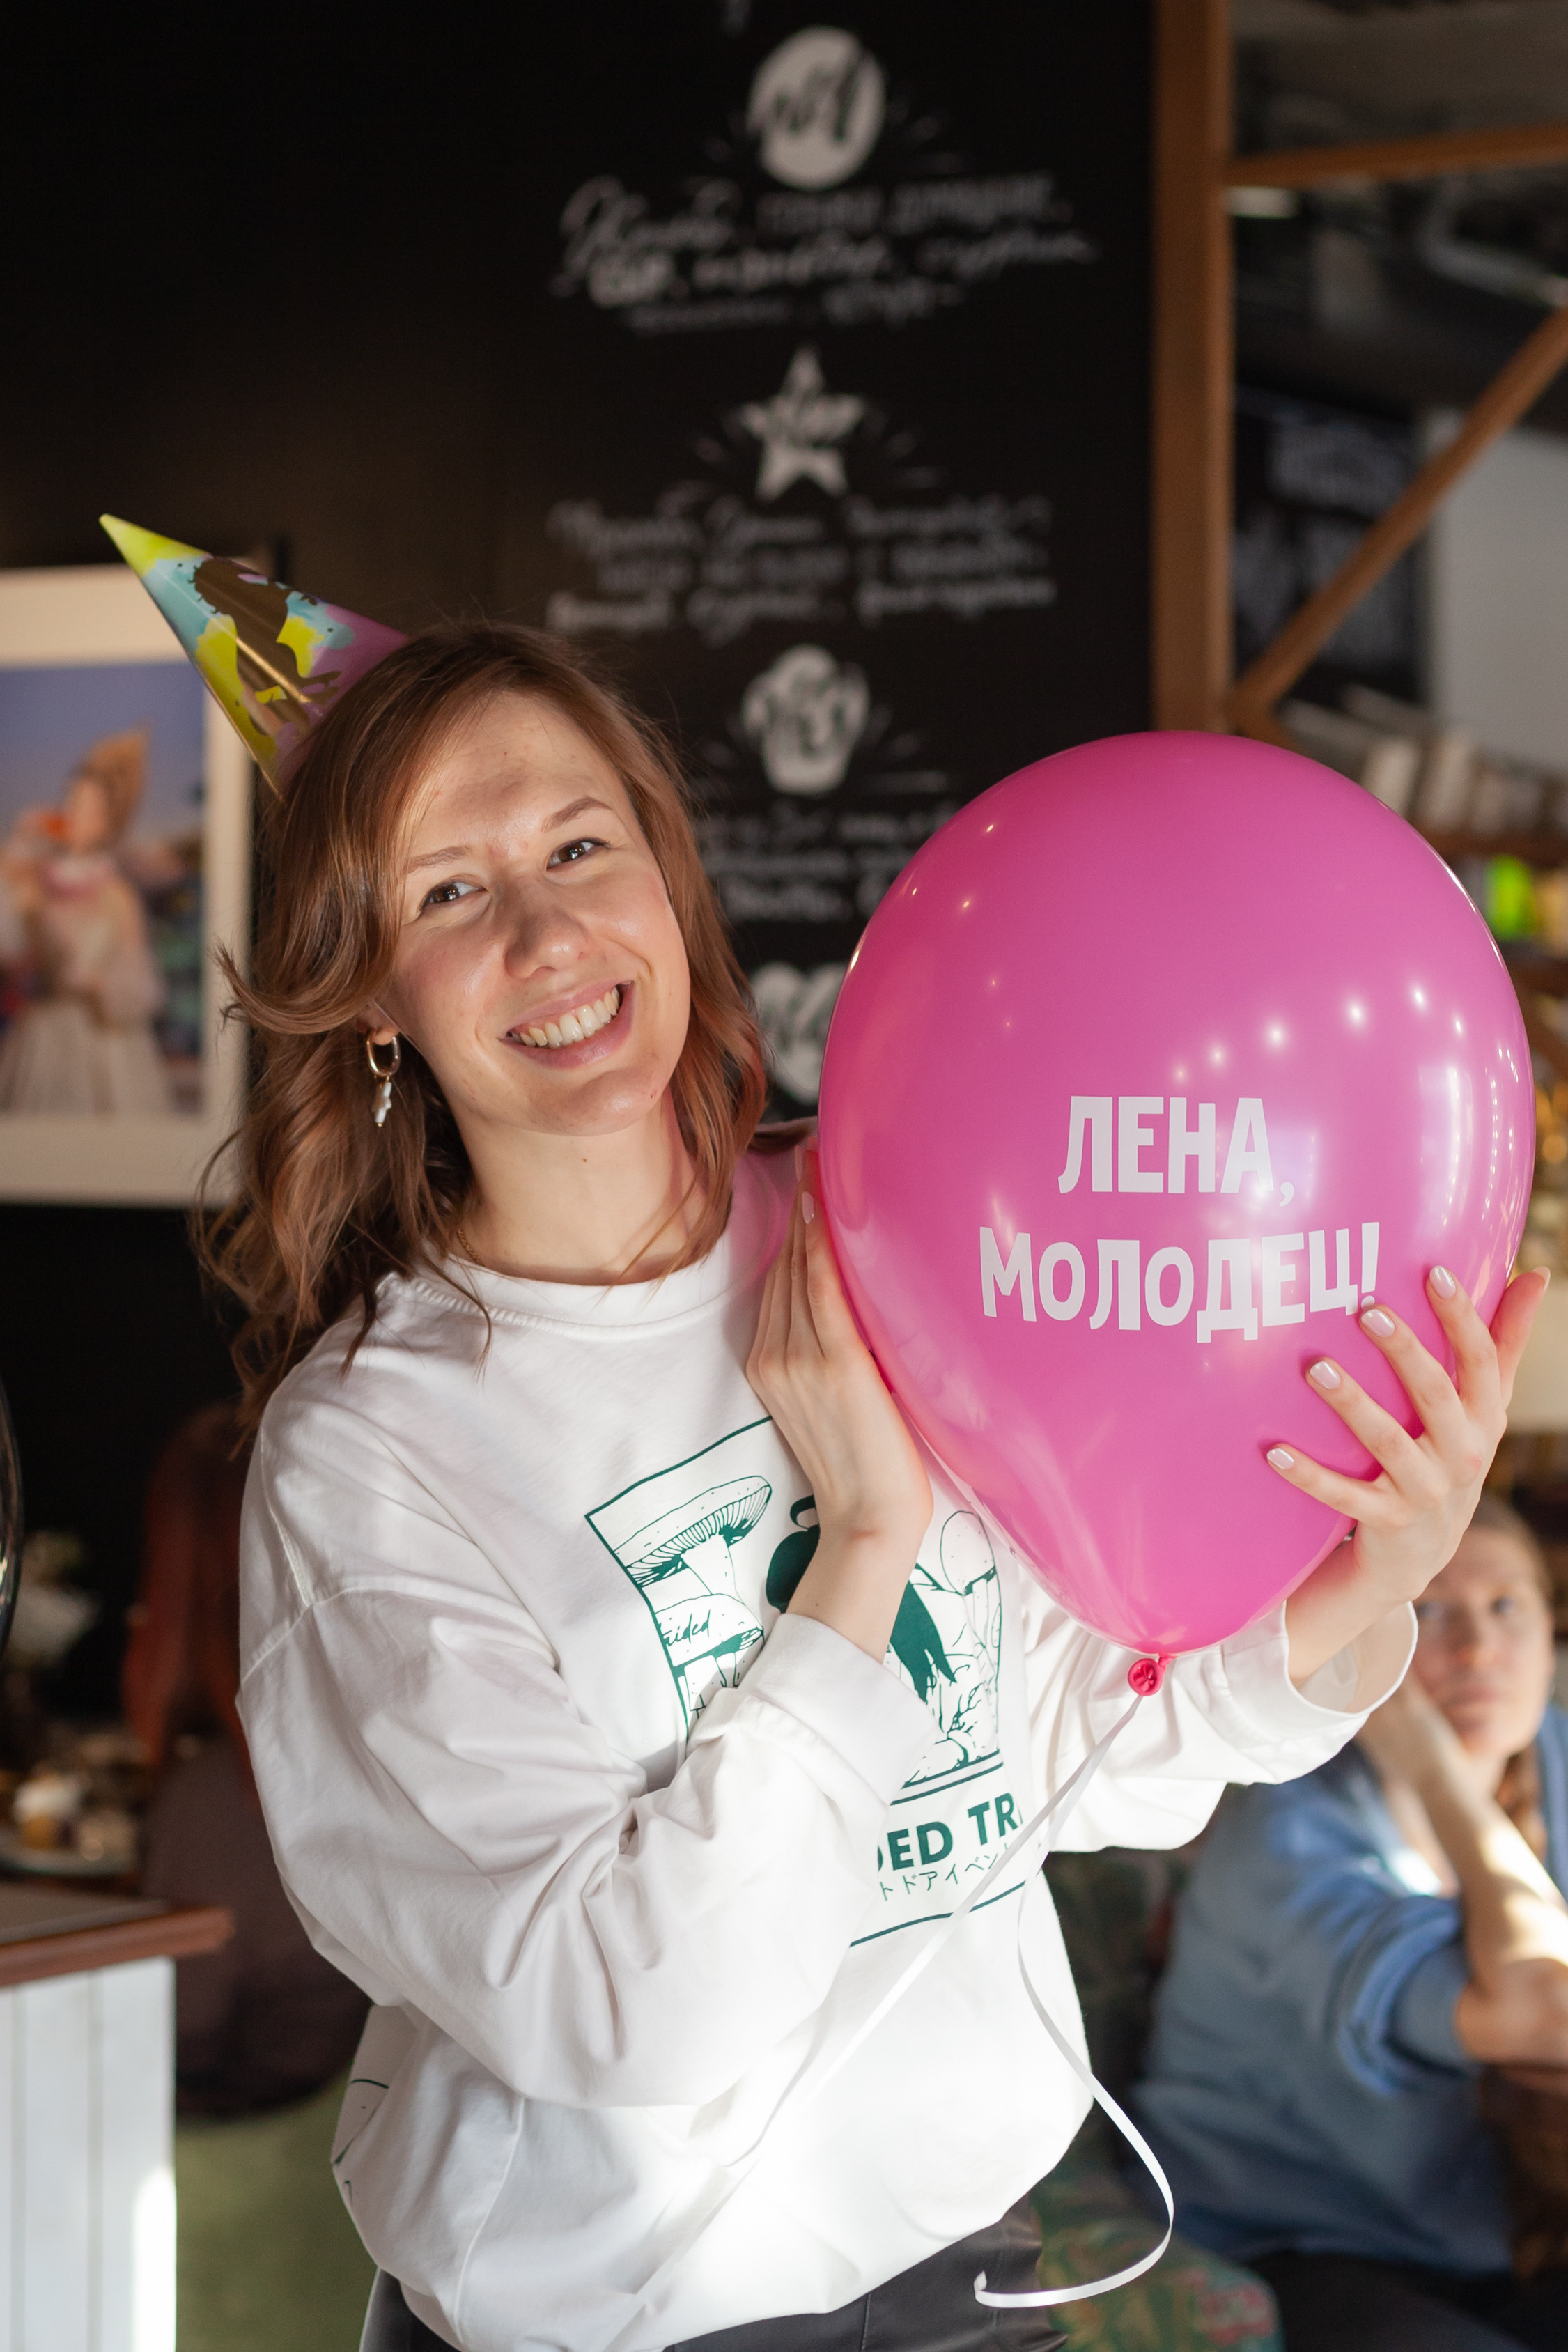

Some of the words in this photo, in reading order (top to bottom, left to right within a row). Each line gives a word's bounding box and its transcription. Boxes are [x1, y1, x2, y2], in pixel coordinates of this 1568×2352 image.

[1057, 1096, 1294, 1206] ЛЕНА,
[979, 1222, 1379, 1343] МОЛОДЕЦ!
[658, 1609, 711, 1647] ided
[877, 1821, 953, 1871] ED
[968, 1793, 1023, 1846] TR
[879, 1843, 1008, 1901] トドアイベン
